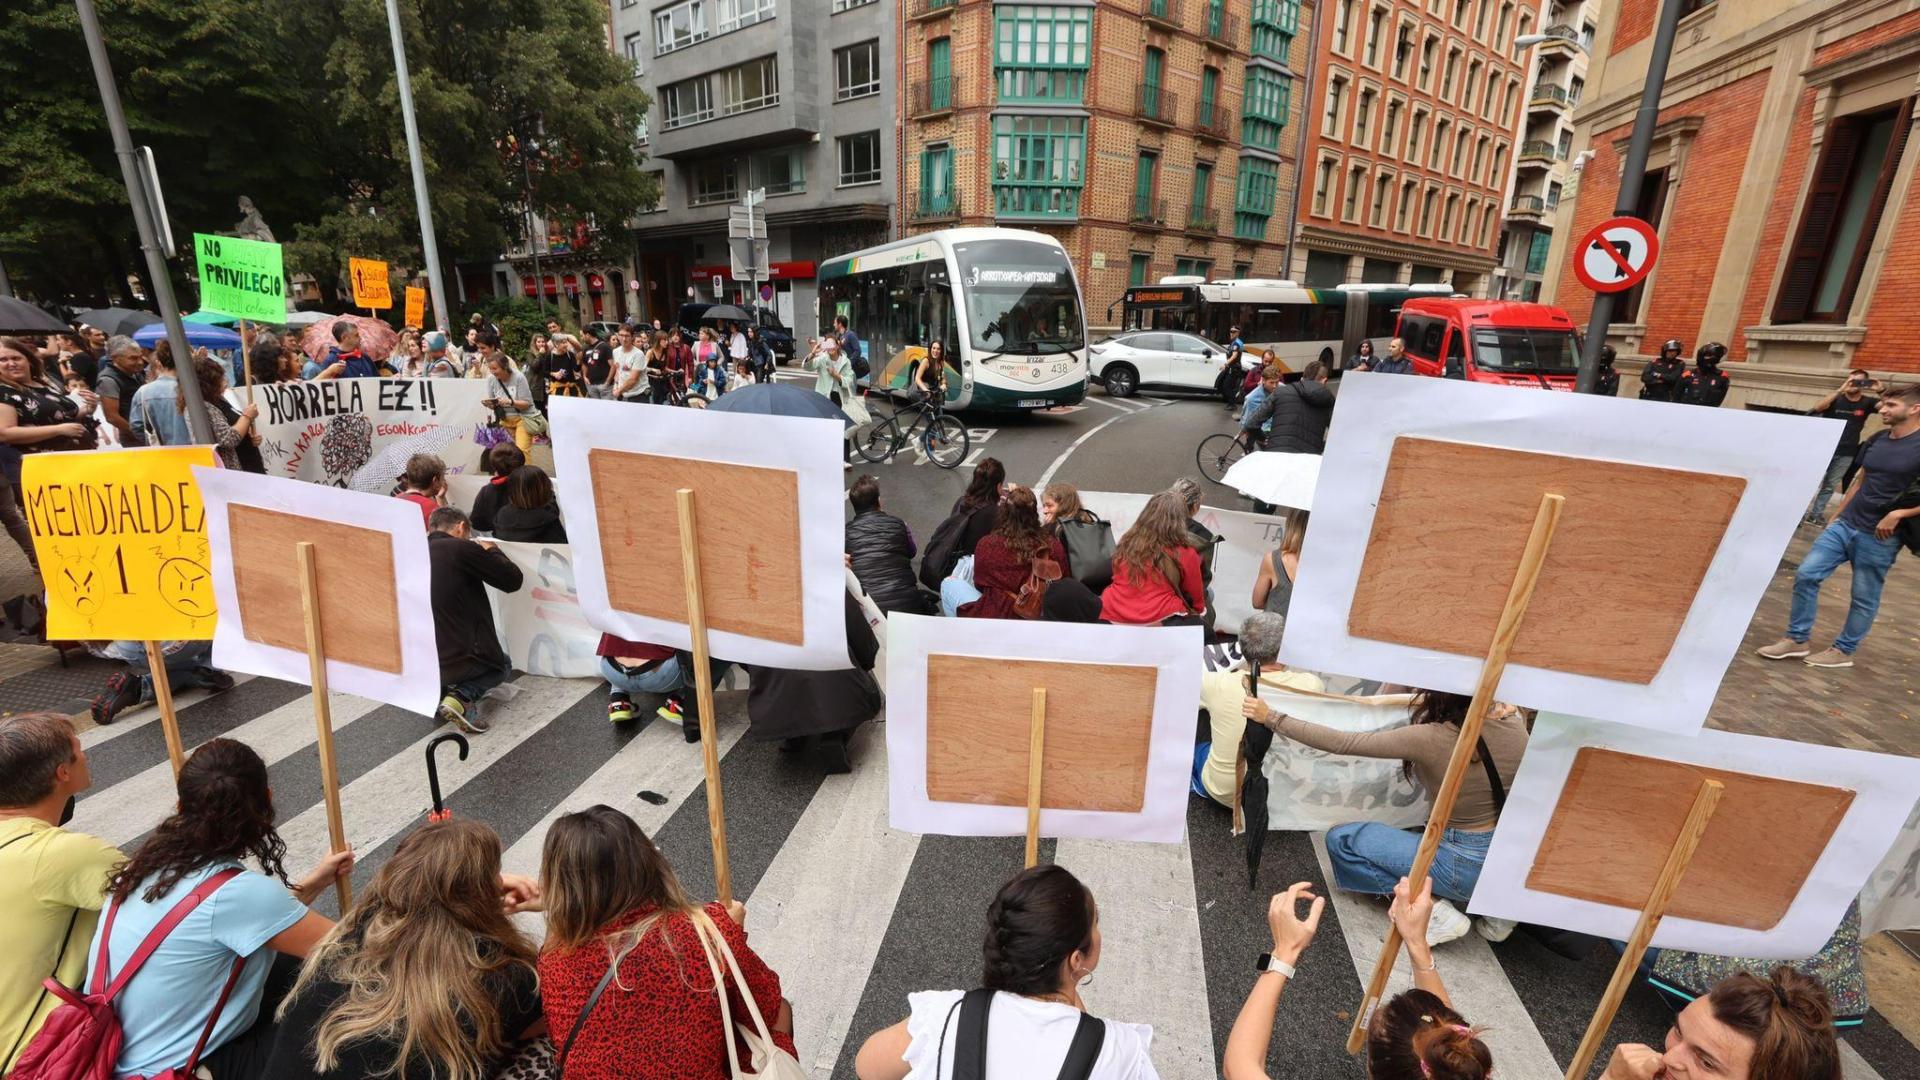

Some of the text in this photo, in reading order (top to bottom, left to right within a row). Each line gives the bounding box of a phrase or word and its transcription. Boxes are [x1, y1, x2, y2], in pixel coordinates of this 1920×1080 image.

[203, 238, 222, 258] NO
[205, 262, 281, 296] PRIVILEGIO
[972, 267, 979, 284] 3
[1051, 363, 1068, 374] 438
[263, 381, 364, 425] HORRELA
[28, 483, 206, 537] MENDIALDE
